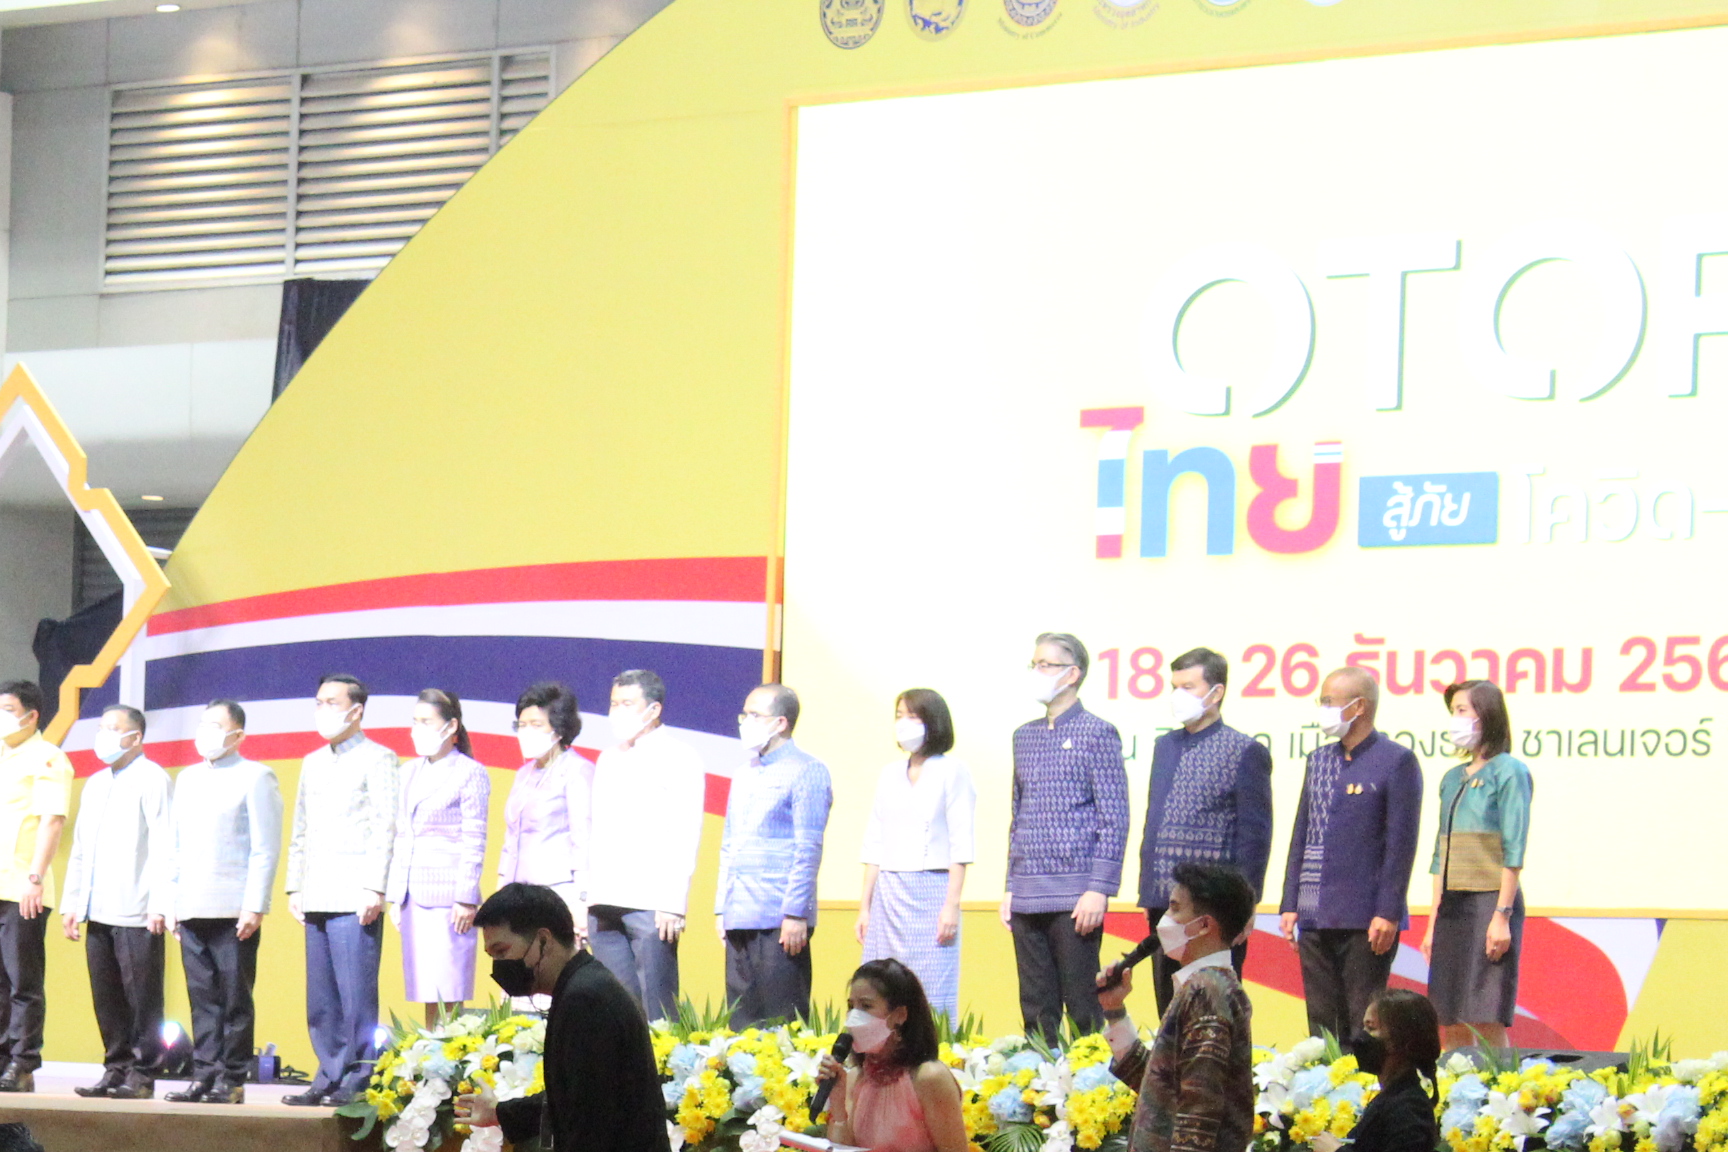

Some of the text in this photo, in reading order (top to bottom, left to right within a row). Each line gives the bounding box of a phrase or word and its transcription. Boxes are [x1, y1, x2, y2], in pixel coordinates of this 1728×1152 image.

[1080, 406, 1343, 559] ไทย
[1382, 481, 1471, 541] สู้ภัย
[1098, 646, 1164, 700] 18
[1241, 642, 1320, 698] 26
[1522, 718, 1714, 758] ชาเลนเจอร์
